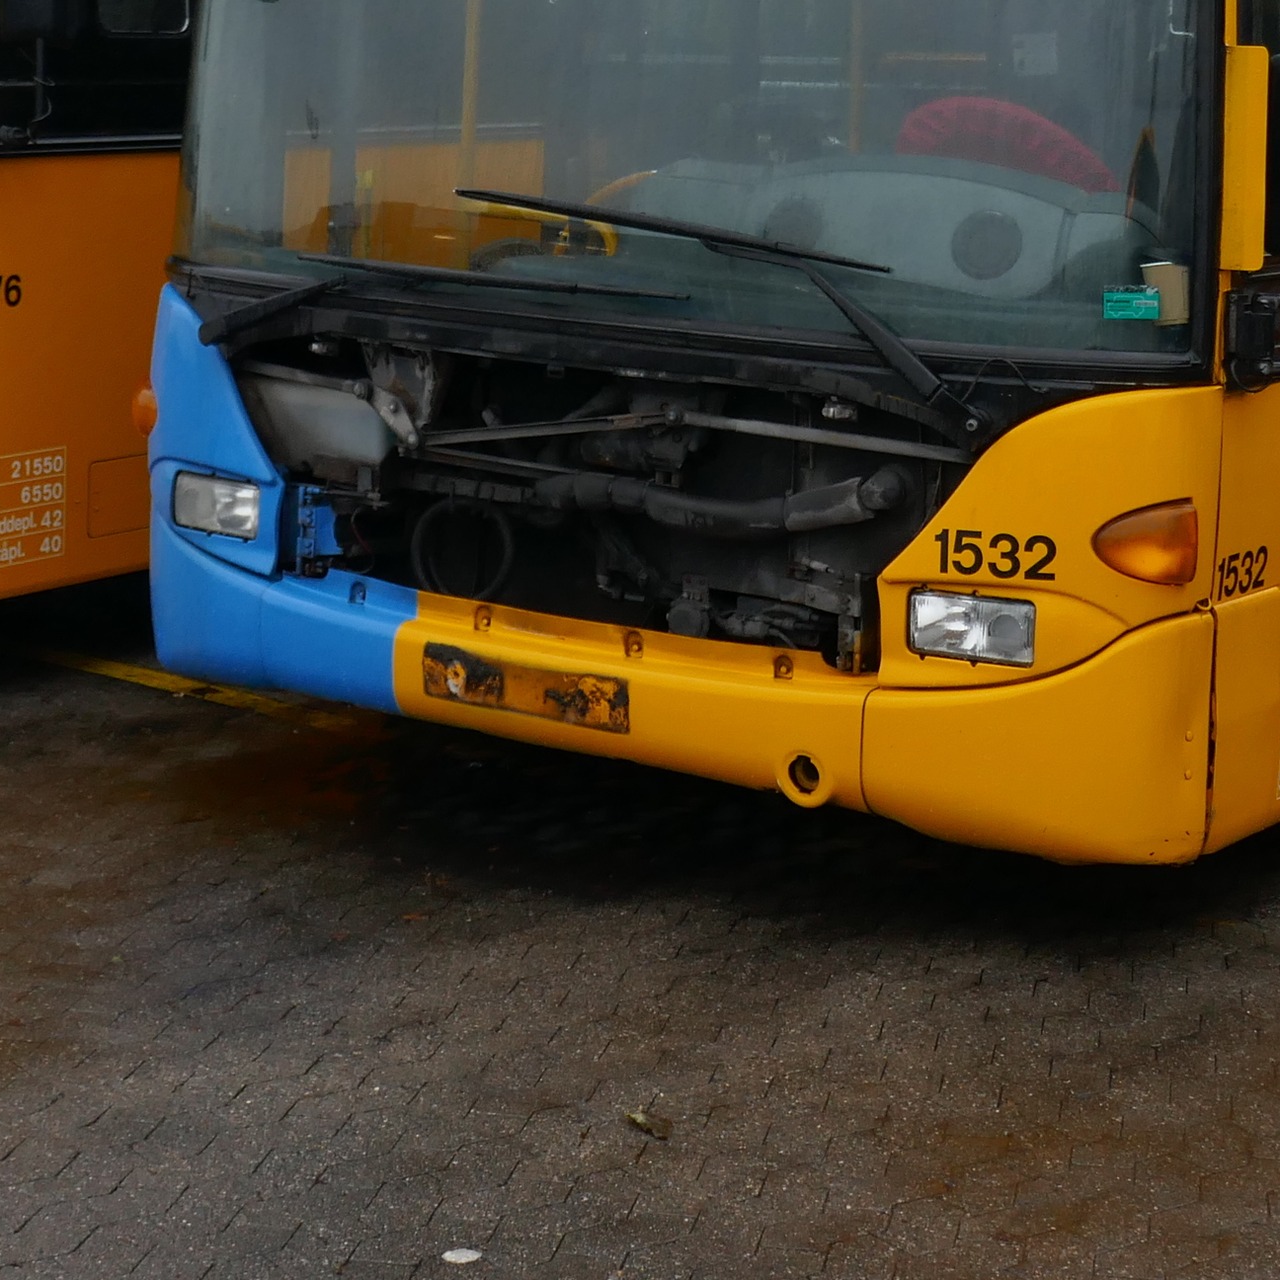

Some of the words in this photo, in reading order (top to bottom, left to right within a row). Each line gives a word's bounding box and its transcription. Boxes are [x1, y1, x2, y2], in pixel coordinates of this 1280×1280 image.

[11, 455, 63, 479] 21550
[21, 482, 63, 503] 6550
[41, 509, 62, 527] 42
[40, 535, 61, 553] 40
[934, 528, 1057, 581] 1532
[1217, 545, 1269, 602] 1532
